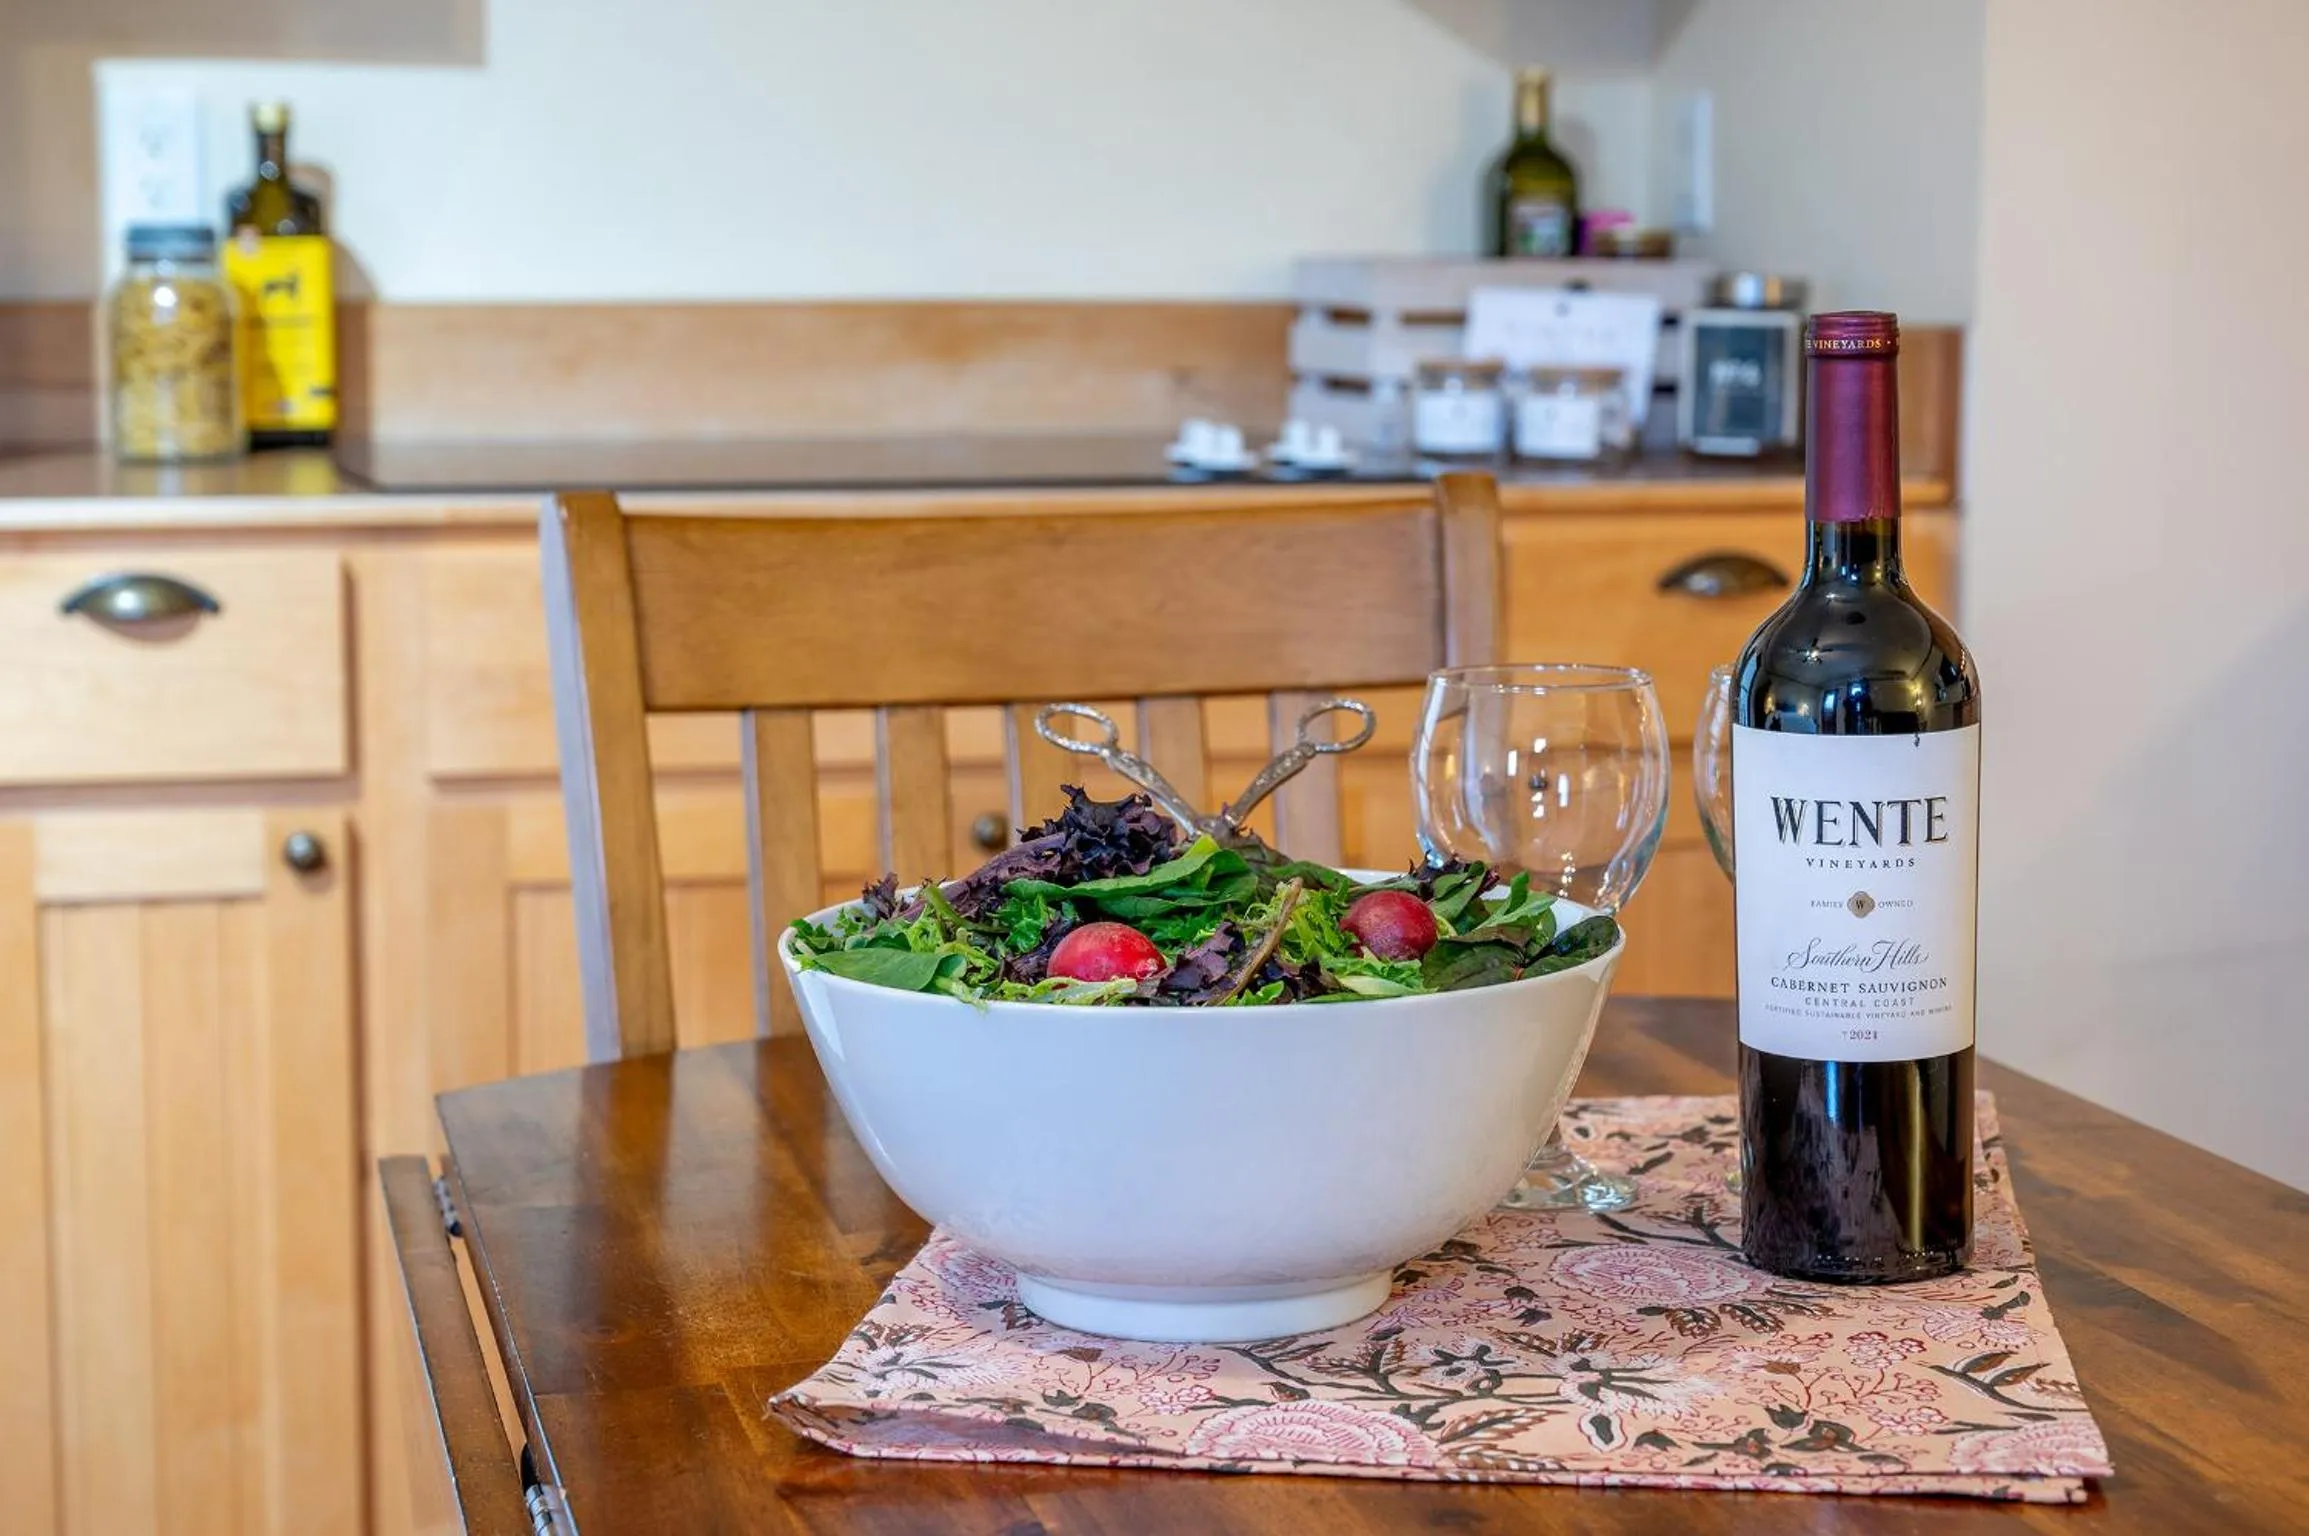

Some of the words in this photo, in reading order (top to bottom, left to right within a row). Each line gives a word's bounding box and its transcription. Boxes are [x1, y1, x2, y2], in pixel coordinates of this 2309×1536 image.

[1812, 338, 1882, 350] VINEYARDS
[1770, 796, 1949, 848] WENTE
[1806, 857, 1915, 869] VINEYARDS
[1878, 900, 1913, 909] OWNED
[1783, 938, 1872, 970] Southern
[1859, 938, 1929, 973] Hills
[1771, 976, 1850, 993] CABERNET
[1859, 977, 1947, 994] SAUVIGNON
[1805, 997, 1865, 1008] CENTRAL
[1874, 997, 1914, 1008] COAST
[1849, 1029, 1878, 1040] 2021
